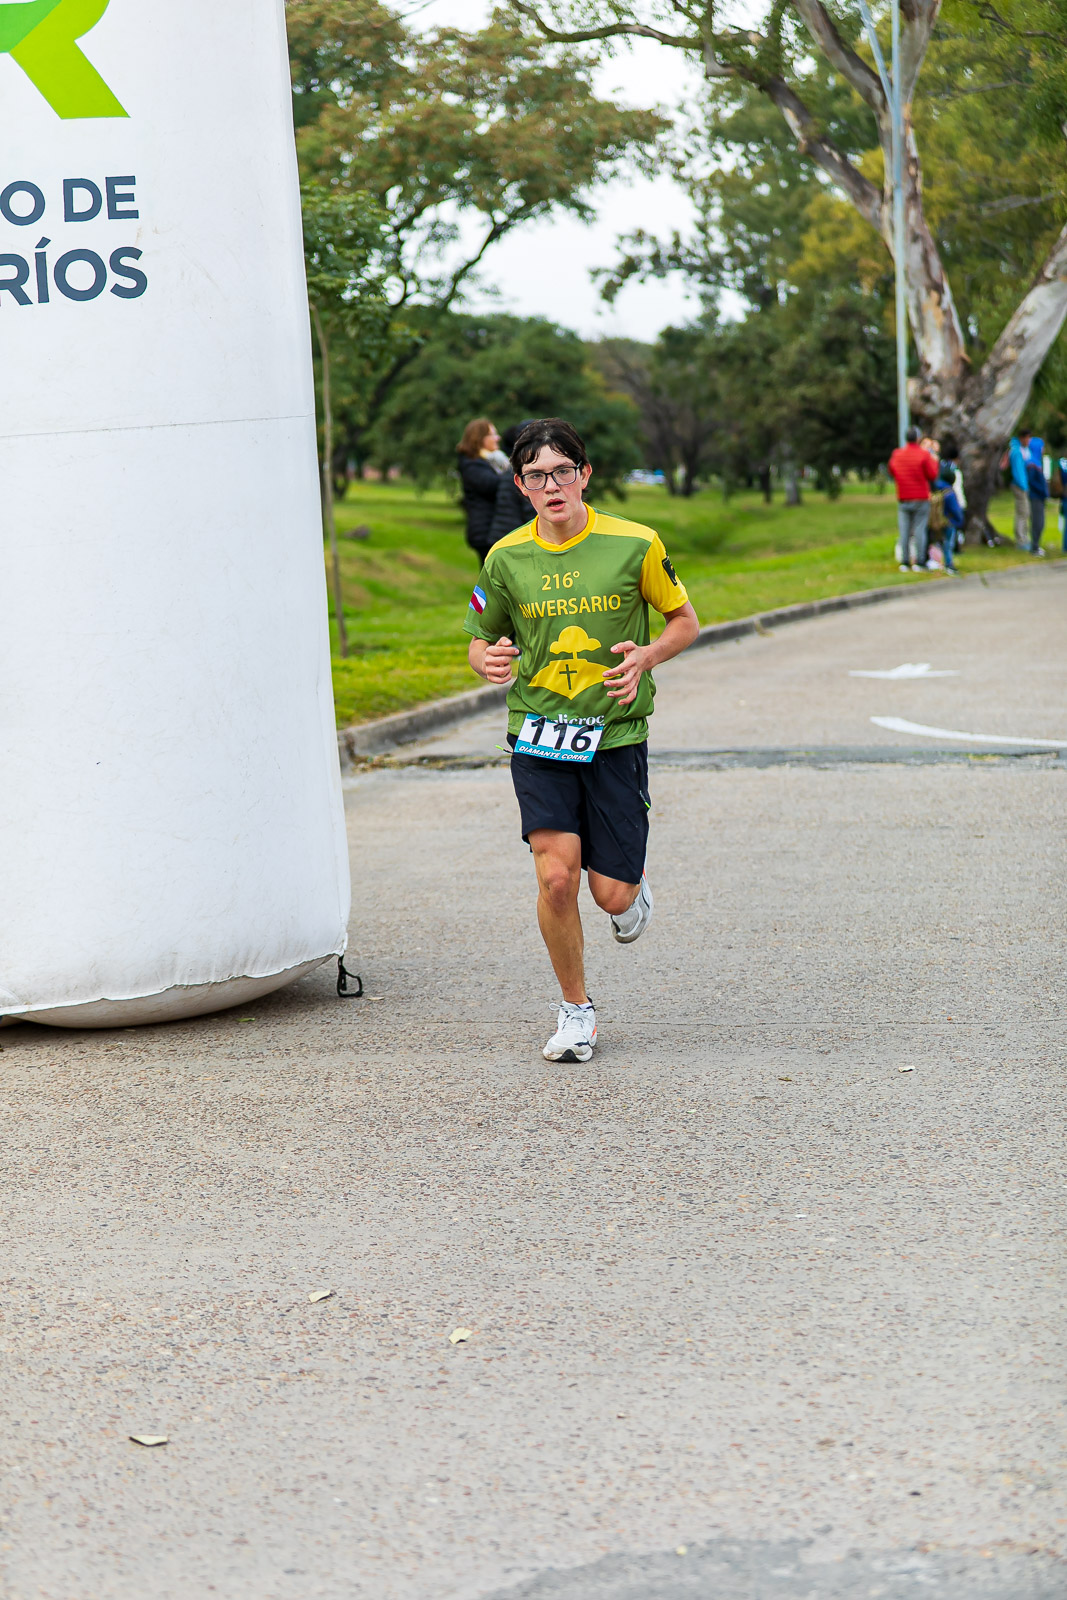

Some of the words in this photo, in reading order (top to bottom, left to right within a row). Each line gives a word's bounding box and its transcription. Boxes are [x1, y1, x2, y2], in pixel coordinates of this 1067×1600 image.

[0, 180, 46, 226] O
[62, 175, 139, 223] DE
[0, 236, 148, 306] RÍOS
[518, 745, 561, 759] DIAMANTE
[560, 753, 590, 761] CORRE
[530, 715, 595, 753] 116
